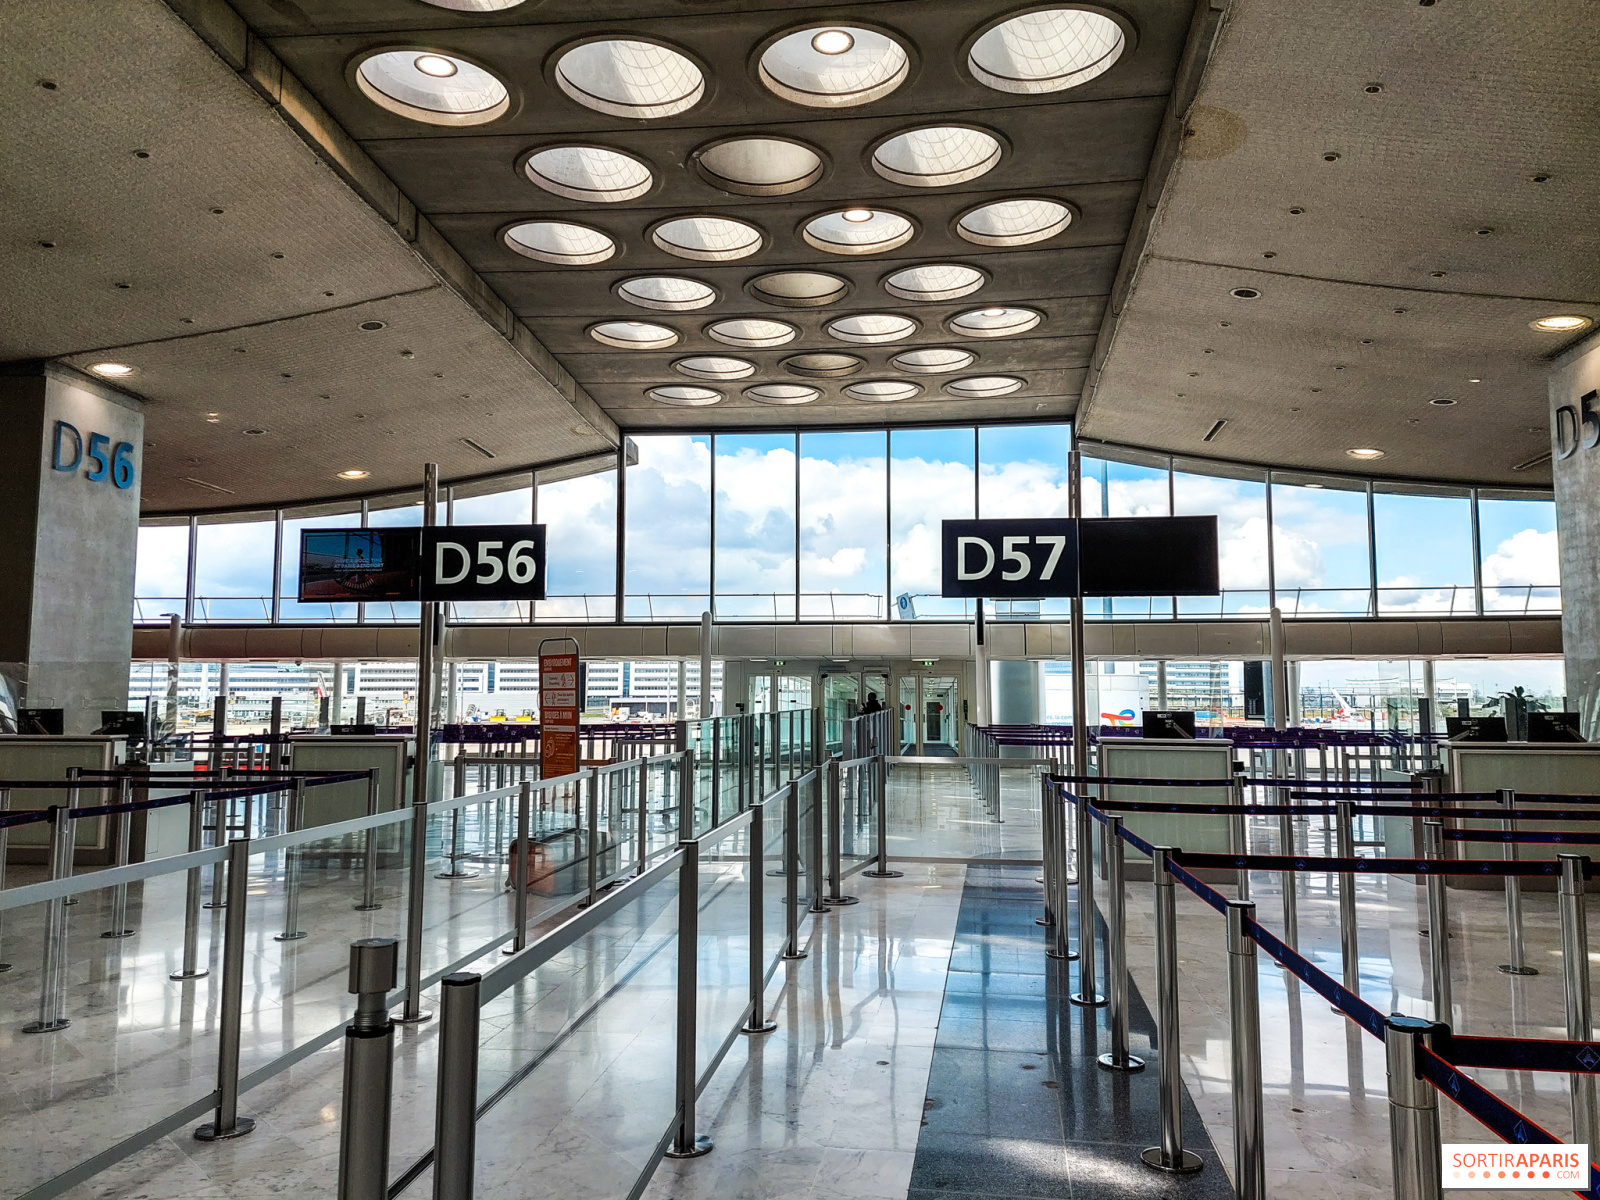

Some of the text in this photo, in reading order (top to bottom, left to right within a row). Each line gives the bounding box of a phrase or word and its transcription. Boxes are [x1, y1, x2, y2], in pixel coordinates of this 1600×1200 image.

[53, 420, 134, 490] D56
[435, 540, 536, 585] D56
[957, 535, 1066, 581] D57
